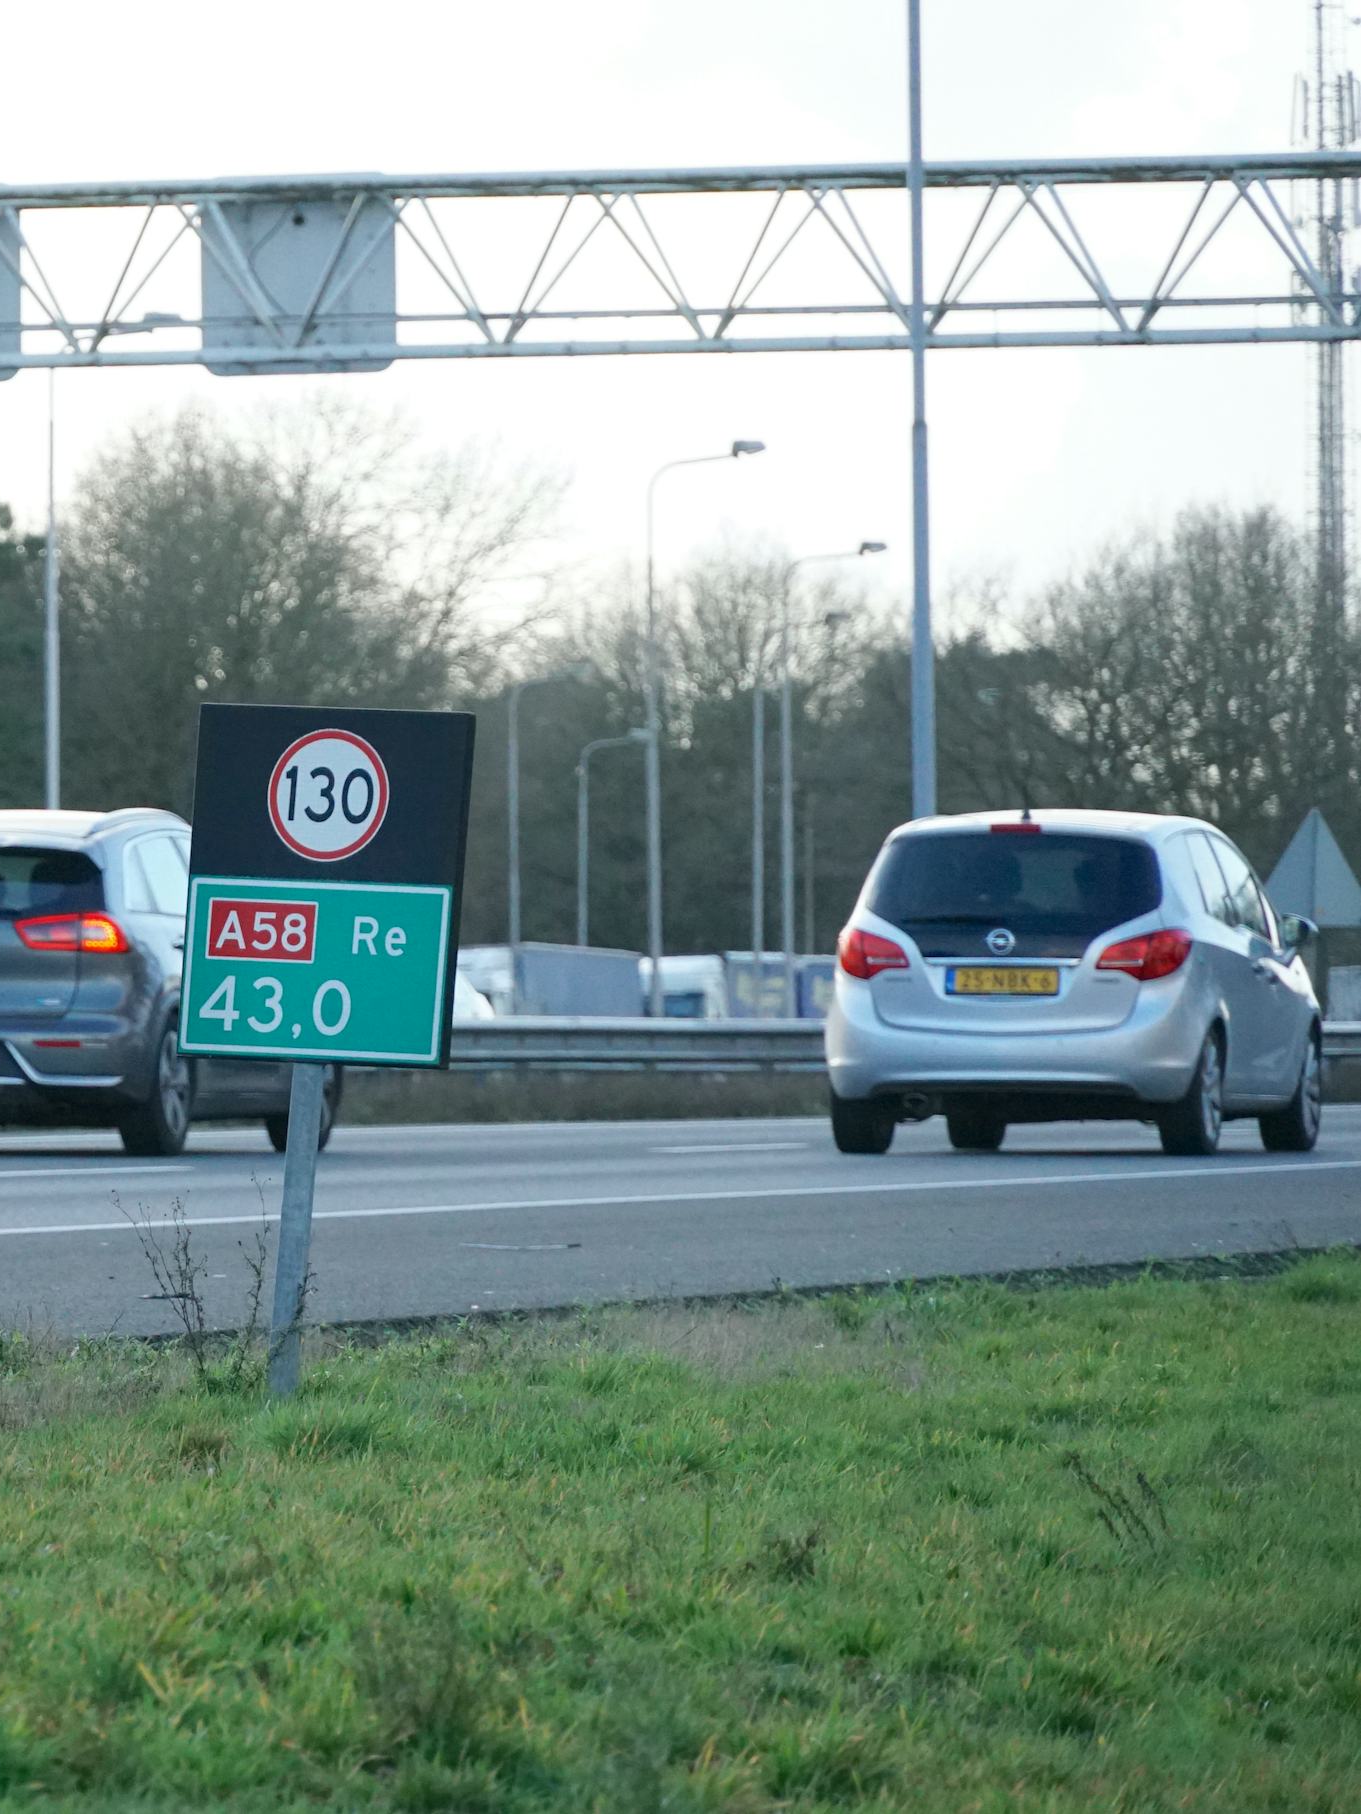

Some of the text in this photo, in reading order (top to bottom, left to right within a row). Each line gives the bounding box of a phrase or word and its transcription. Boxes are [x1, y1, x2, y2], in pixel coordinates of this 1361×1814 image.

[285, 765, 375, 824] 130
[215, 910, 407, 957] A58 Re
[198, 975, 352, 1039] 43,0
